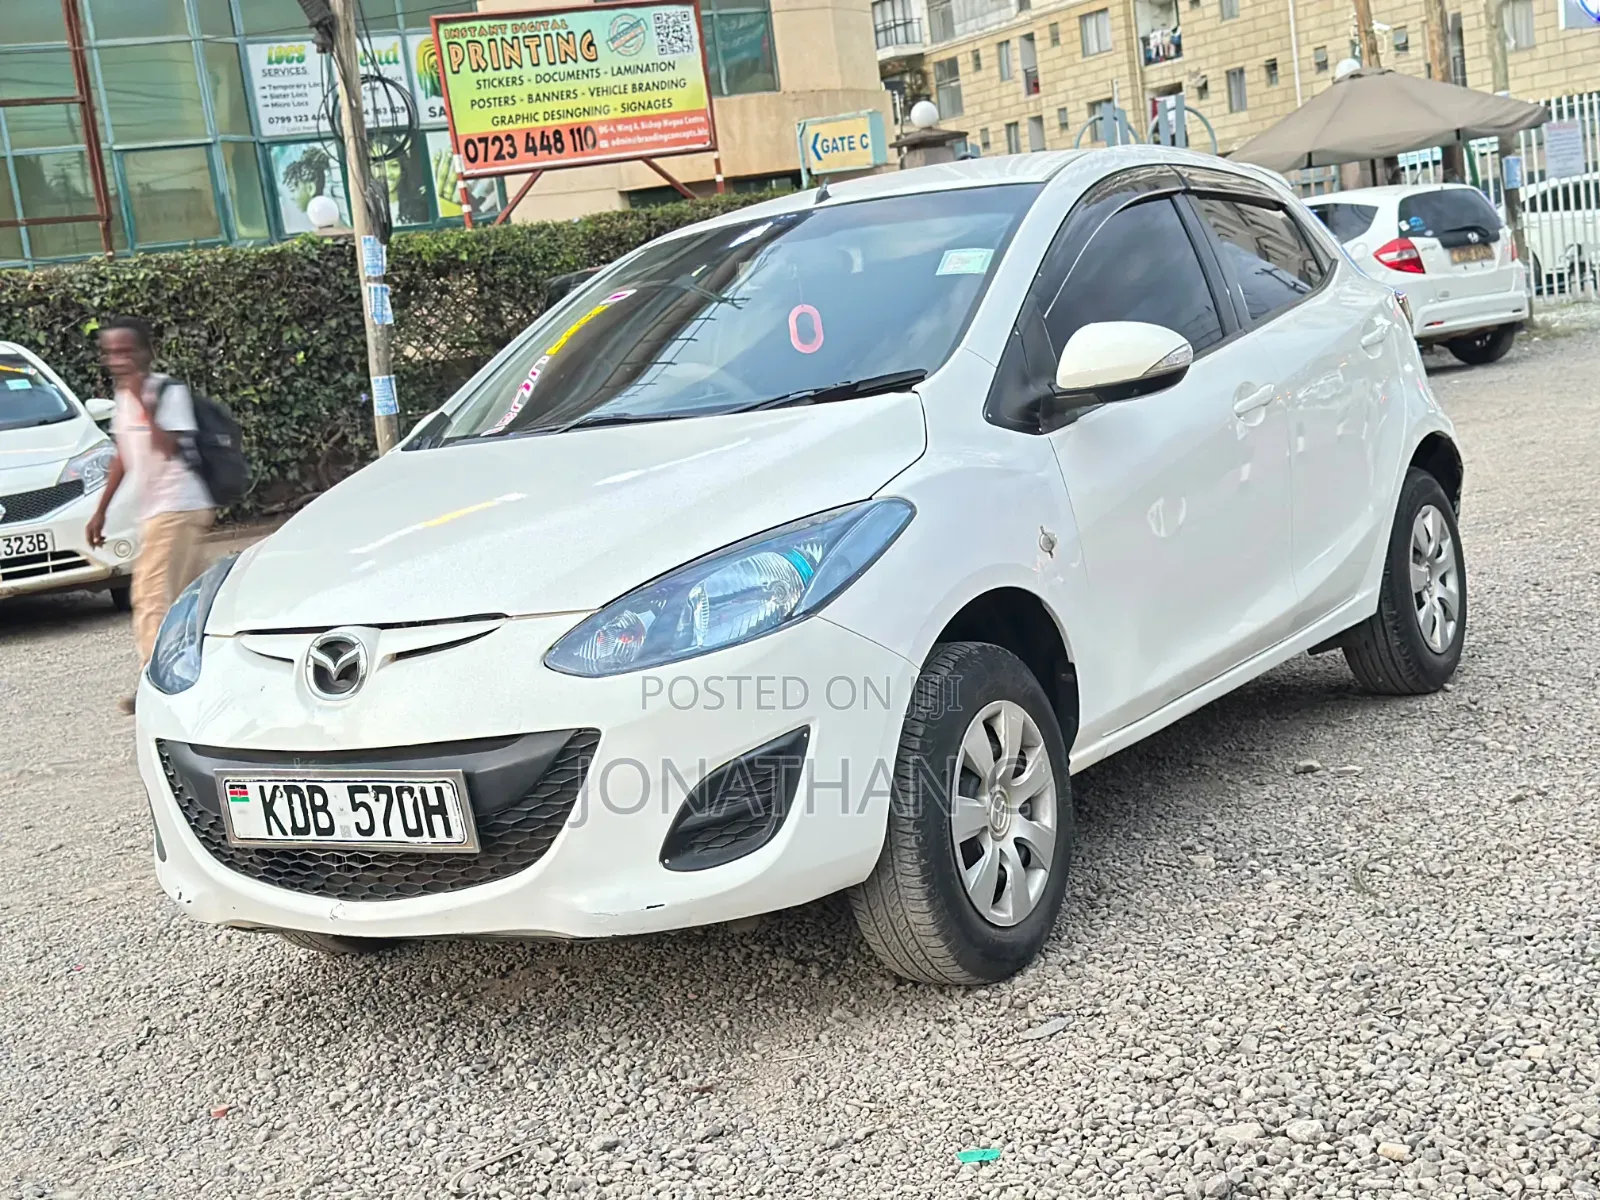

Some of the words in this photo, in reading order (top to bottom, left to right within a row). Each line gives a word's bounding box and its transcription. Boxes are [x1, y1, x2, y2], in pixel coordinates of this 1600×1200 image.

[444, 24, 509, 40] INSTANT
[511, 18, 569, 35] DIGITAL
[266, 44, 306, 66] LOCS
[446, 29, 598, 75] PRINTING
[261, 66, 308, 78] SERVICES
[476, 75, 525, 91] STICKERS
[534, 68, 601, 85] DOCUMENTS
[611, 60, 677, 77] LAMINATION
[268, 83, 307, 91] Temporary
[470, 92, 516, 110] POSTERS
[527, 88, 579, 105] BANNERS
[588, 83, 629, 98] VEHICLE
[631, 78, 688, 94] BRANDING
[268, 115, 292, 125] 0799
[293, 114, 309, 122] 123
[491, 110, 540, 127] GRAPHIC
[543, 104, 612, 122] DESINGNING
[620, 98, 674, 114] SIGNAGES
[463, 133, 518, 165] 0723
[524, 128, 566, 157] 448
[570, 125, 598, 153] 110
[820, 134, 857, 155] GATE
[859, 132, 870, 150] C
[3, 533, 49, 557] 323B
[258, 784, 336, 837] KDB
[347, 784, 455, 838] 570H
